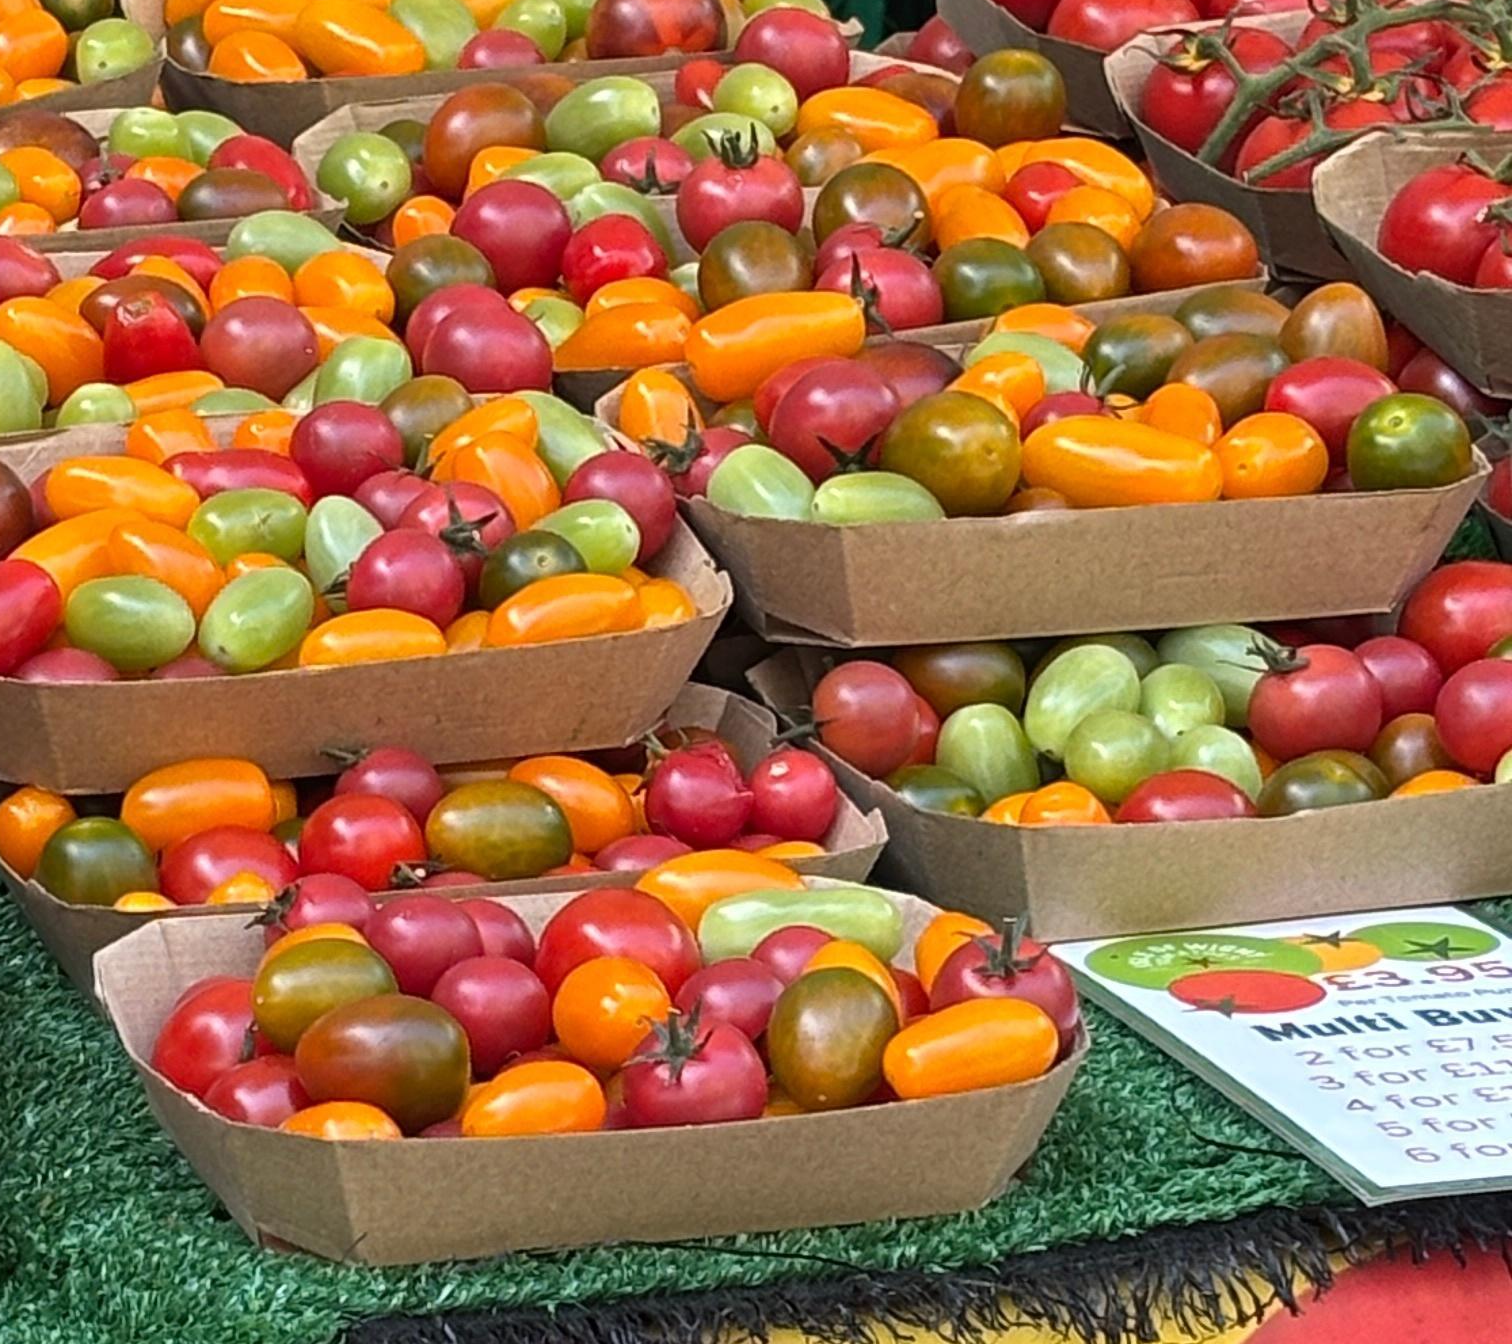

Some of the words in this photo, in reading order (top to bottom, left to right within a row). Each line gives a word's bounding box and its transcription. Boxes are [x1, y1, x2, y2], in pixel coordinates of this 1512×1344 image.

[1322, 959, 1512, 991] £3.95
[1380, 990, 1471, 1004] Tomato
[1250, 1012, 1409, 1042] Multi
[1295, 1050, 1335, 1066] 2
[1338, 1044, 1412, 1061] for
[1308, 1075, 1346, 1090] 3
[1354, 1068, 1428, 1087] for
[1346, 1098, 1377, 1112] 4
[1385, 1093, 1459, 1110] for
[1376, 1121, 1413, 1138] 5
[1422, 1117, 1497, 1134] for
[1405, 1146, 1441, 1163] 6
[1450, 1142, 1512, 1159] fo
